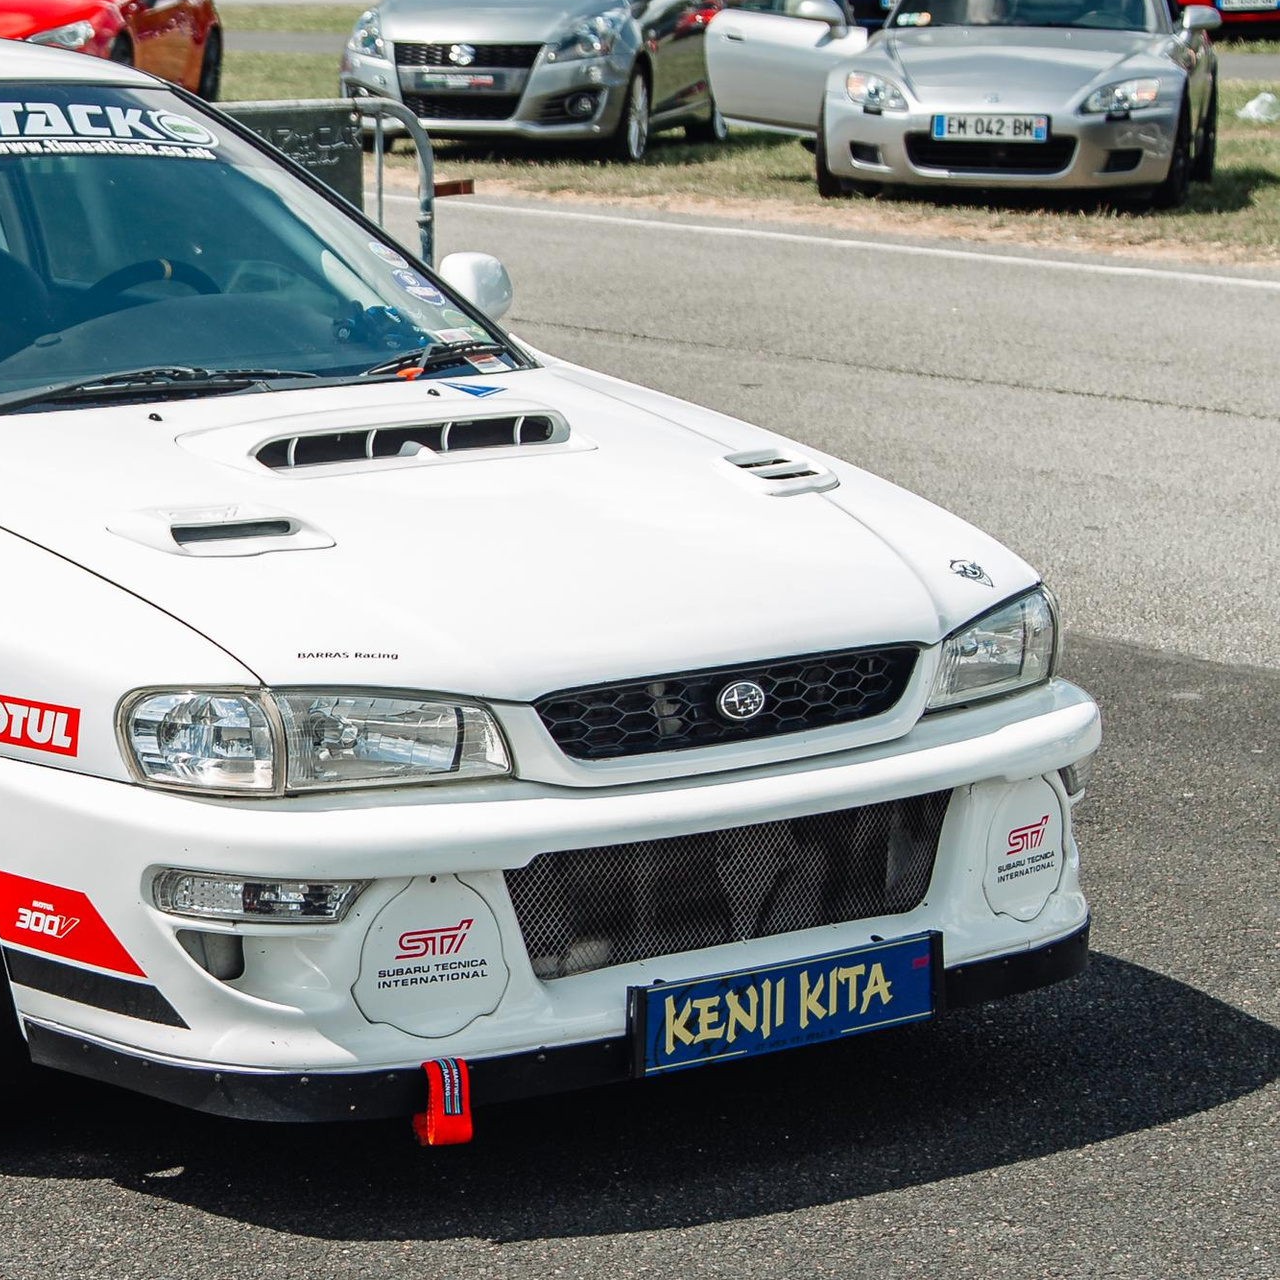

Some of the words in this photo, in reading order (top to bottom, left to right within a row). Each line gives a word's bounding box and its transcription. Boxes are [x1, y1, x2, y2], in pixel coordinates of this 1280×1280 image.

[297, 651, 350, 659] BARRAS
[354, 652, 399, 660] Racing
[997, 858, 1026, 874] SUBARU
[1027, 850, 1055, 864] TECNICA
[997, 861, 1055, 884] INTERNATIONAL
[15, 907, 81, 939] 300V
[378, 965, 430, 978] SUBARU
[434, 959, 488, 972] TECNICA
[378, 970, 488, 989] INTERNATIONAL
[799, 962, 894, 1030] KITA
[442, 1068, 451, 1097] RACING
